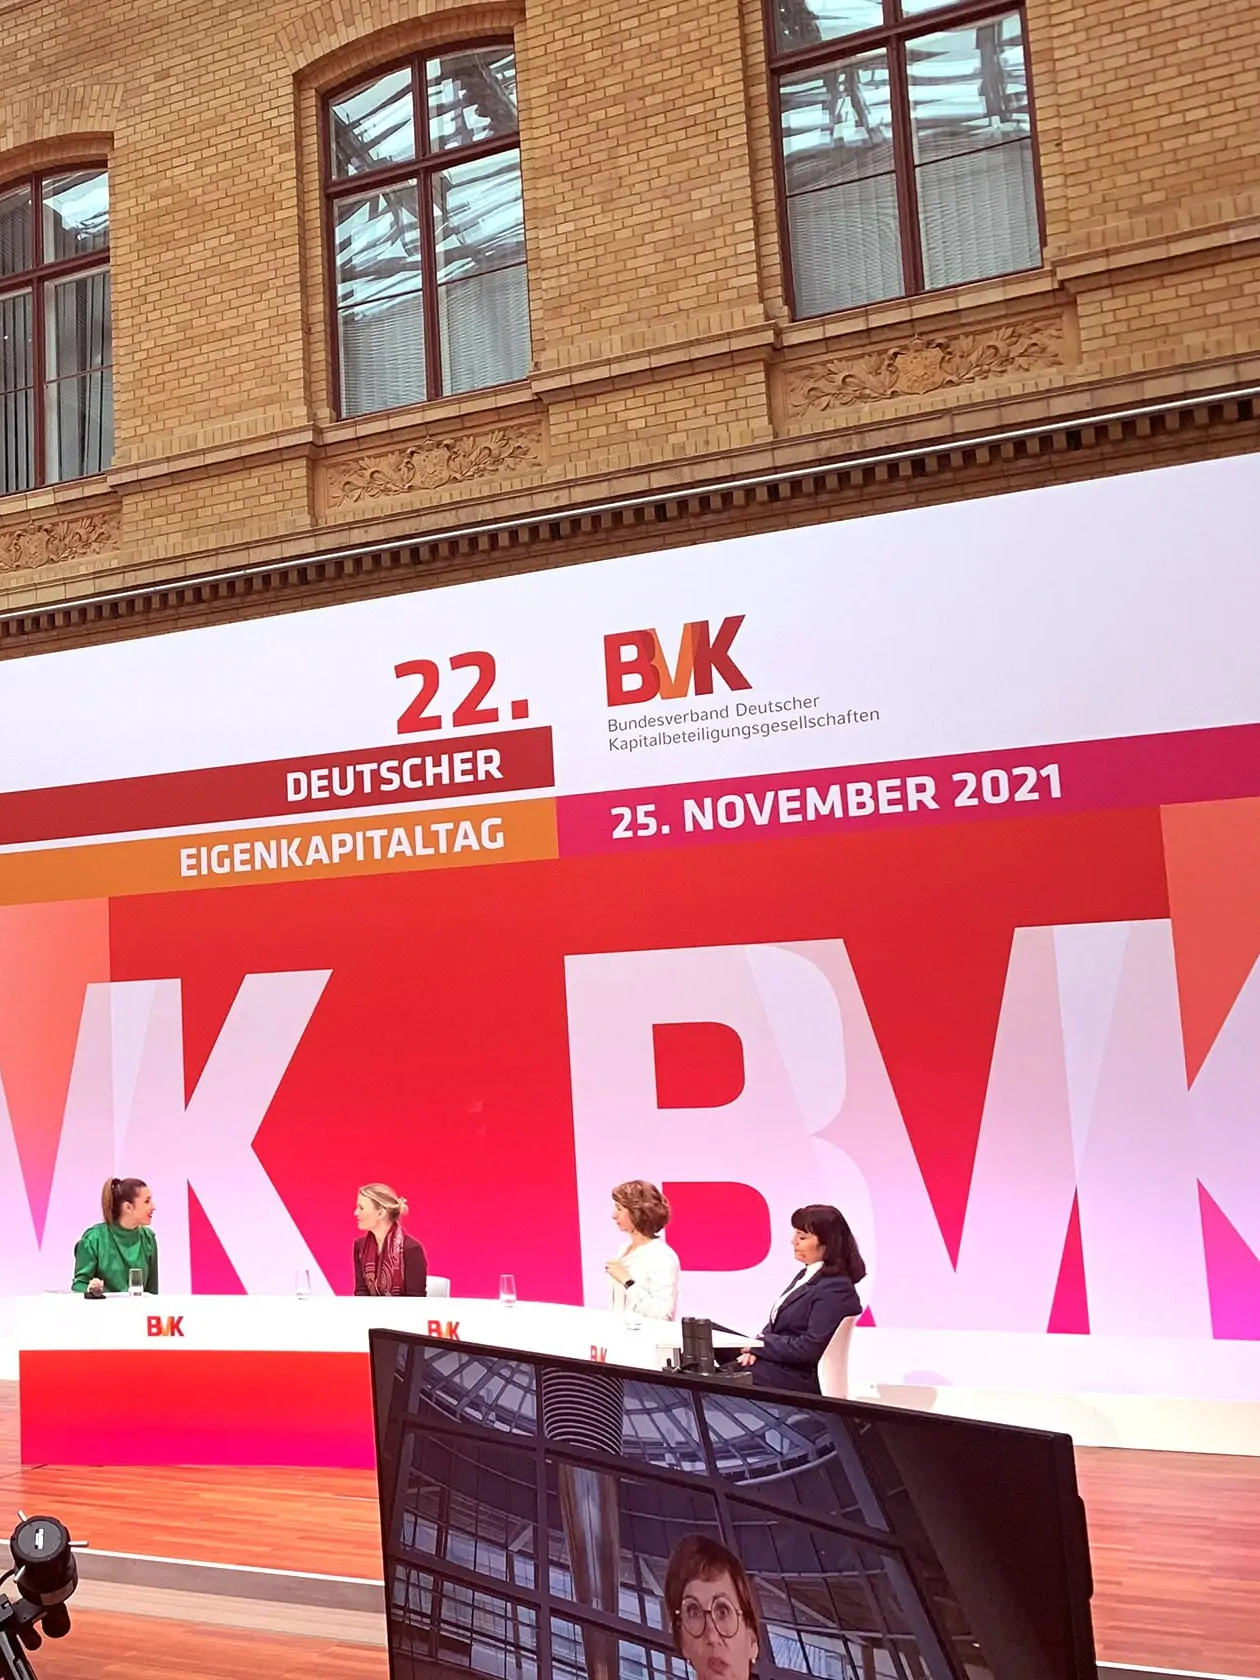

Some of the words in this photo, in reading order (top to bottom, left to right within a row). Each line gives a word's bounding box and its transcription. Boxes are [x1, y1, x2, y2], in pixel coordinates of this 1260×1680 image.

[603, 614, 753, 707] BVK
[394, 650, 530, 734] 22.
[608, 705, 729, 732] Bundesverband
[736, 696, 820, 716] Deutscher
[609, 709, 880, 752] Kapitalbeteiligungsgesellschaften
[286, 749, 503, 802] DEUTSCHER
[610, 805, 670, 840] 25.
[684, 774, 940, 833] NOVEMBER
[952, 763, 1064, 808] 2021
[179, 817, 505, 878] EIGENKAPITALTAG
[147, 1315, 185, 1337] BVK
